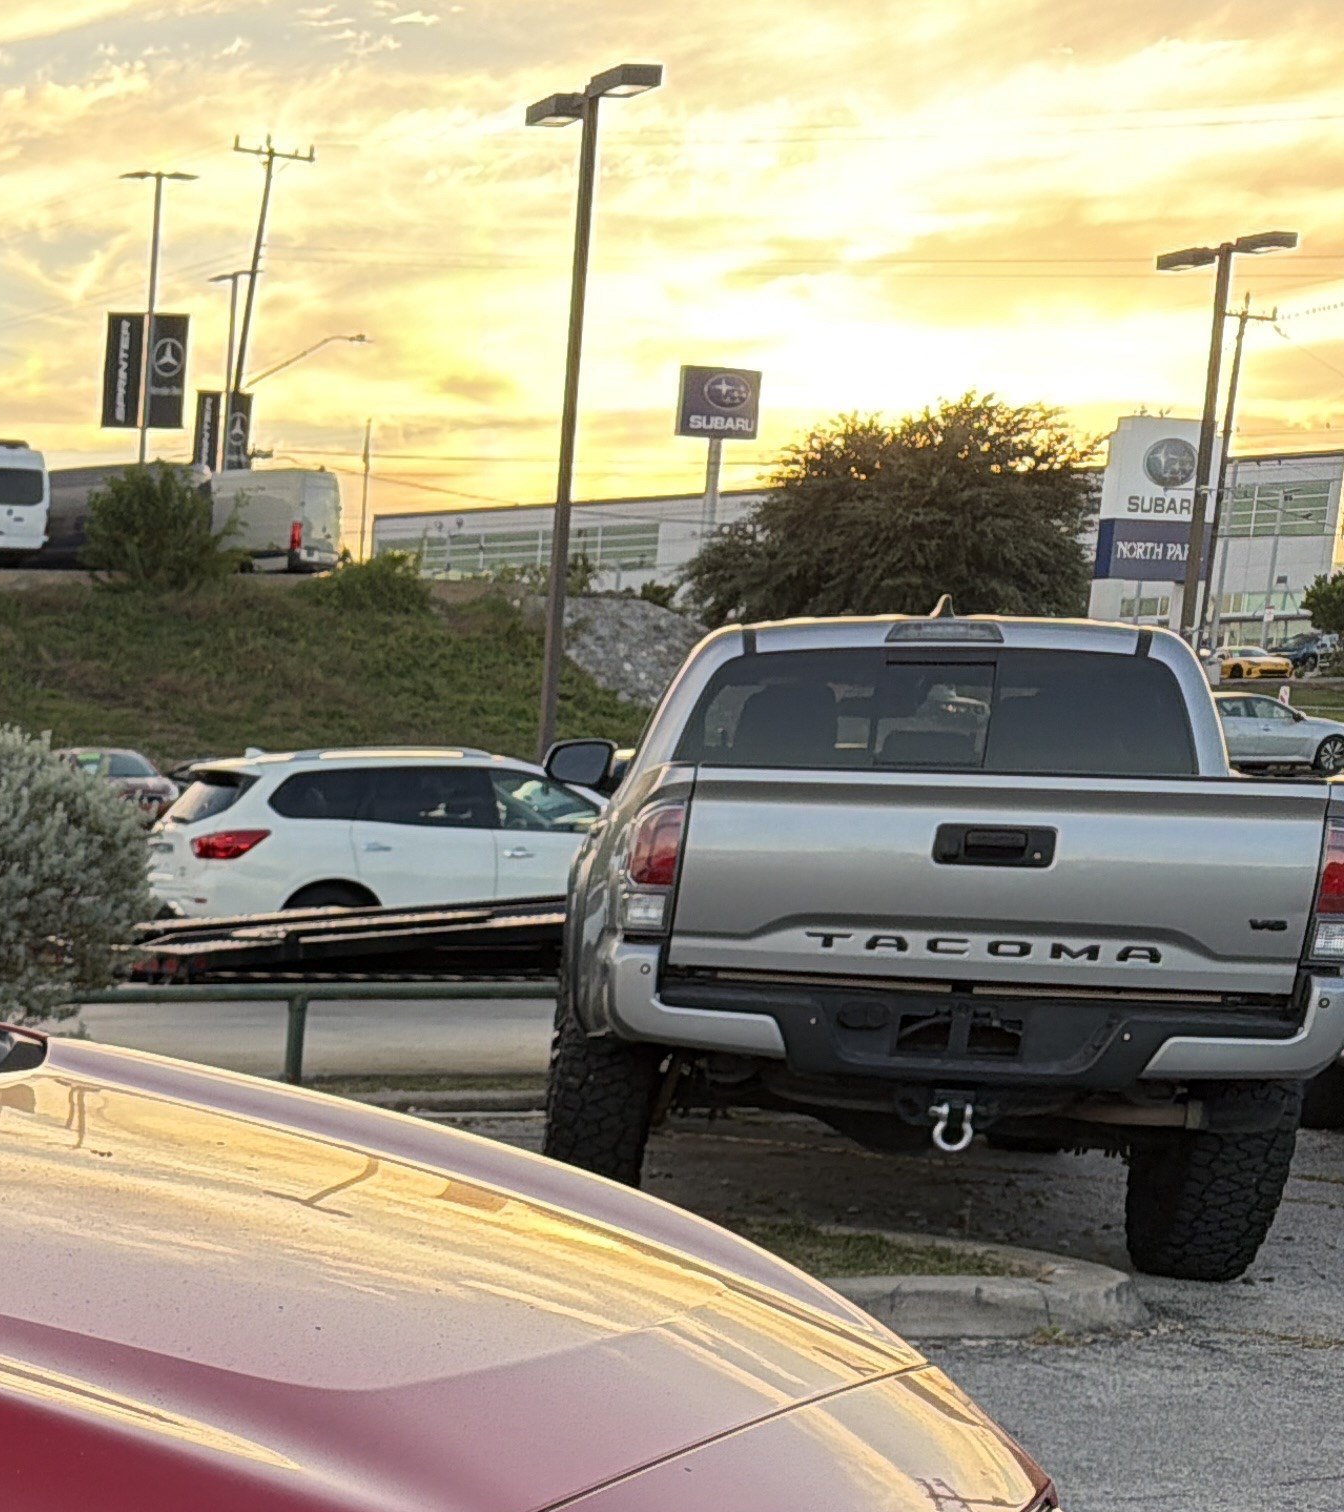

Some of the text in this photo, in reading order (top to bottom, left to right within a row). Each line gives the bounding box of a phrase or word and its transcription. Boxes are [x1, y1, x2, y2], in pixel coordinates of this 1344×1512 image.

[689, 414, 753, 432] SUBARU
[1127, 495, 1191, 515] SUBAR
[1116, 541, 1163, 560] NORTH
[805, 930, 1162, 964] TACOMA
